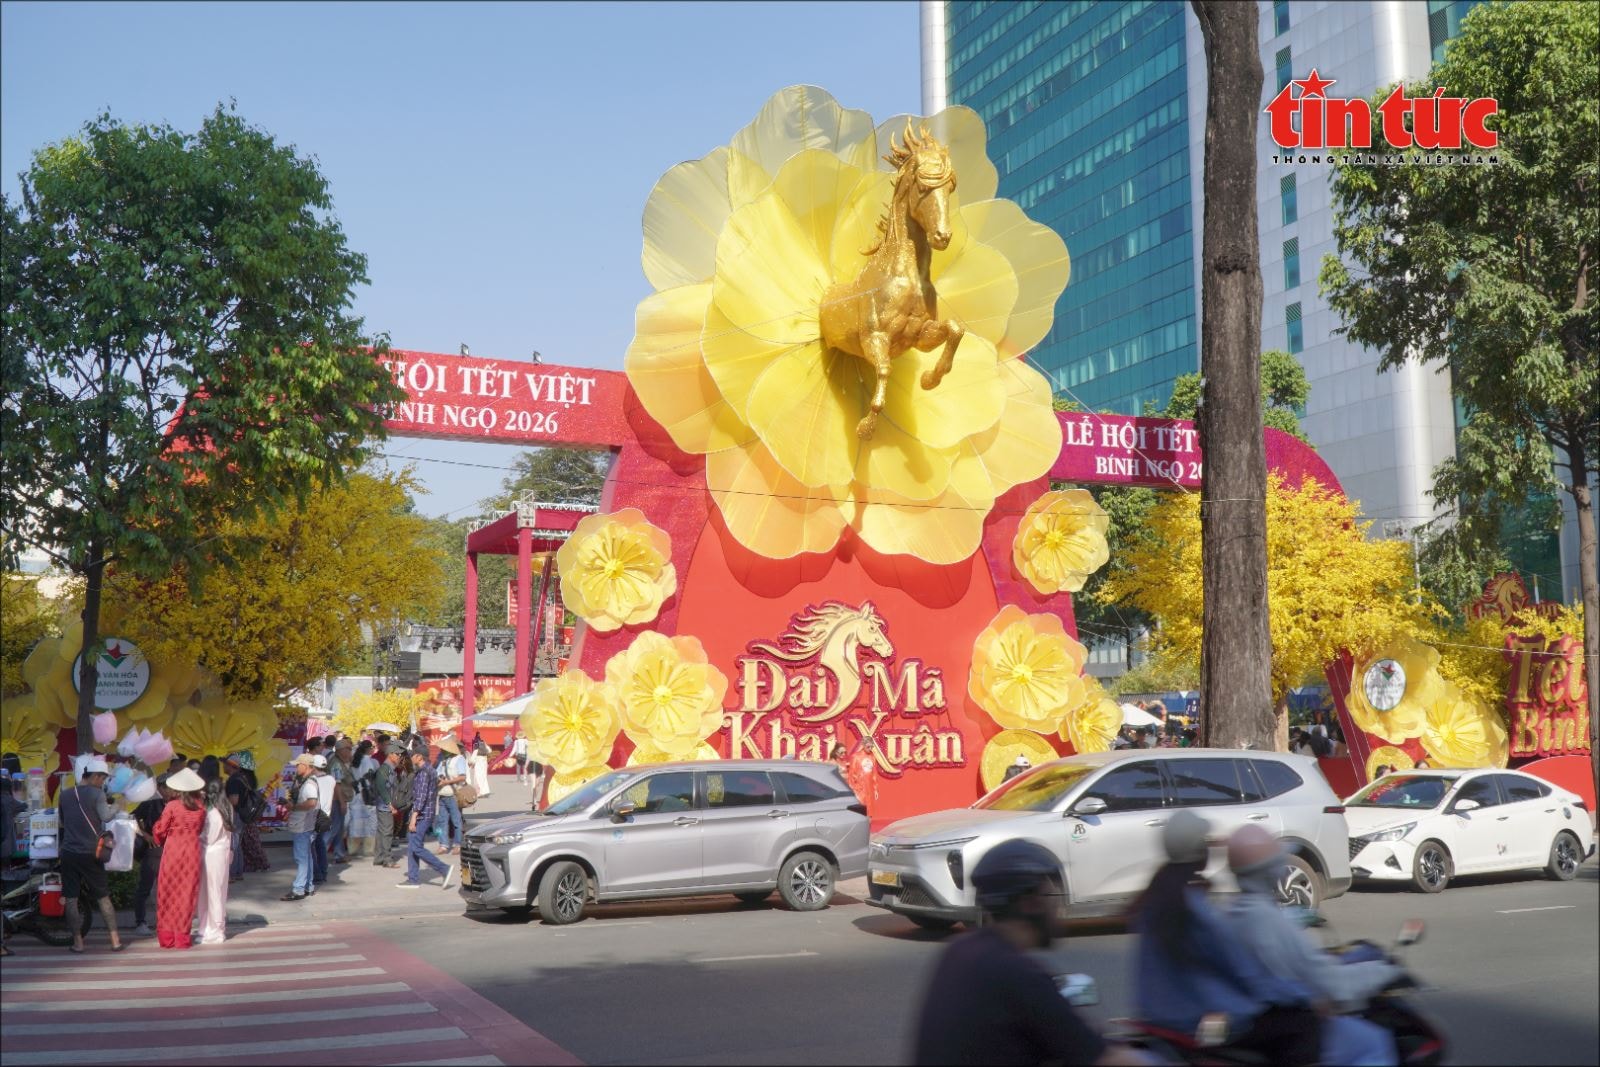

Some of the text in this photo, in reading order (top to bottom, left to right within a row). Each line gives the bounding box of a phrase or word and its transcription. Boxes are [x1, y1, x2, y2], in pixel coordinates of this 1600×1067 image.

[457, 362, 518, 398] TẾT
[525, 372, 596, 409] VIỆT
[442, 404, 497, 434] NGỌ
[504, 409, 558, 434] 2026
[1066, 415, 1197, 455] LỄ HỘI TẾT
[1095, 454, 1141, 477] BÍNH
[1144, 459, 1185, 483] NGỌ
[738, 658, 946, 716] Đại Mã
[850, 711, 964, 773] Xuân
